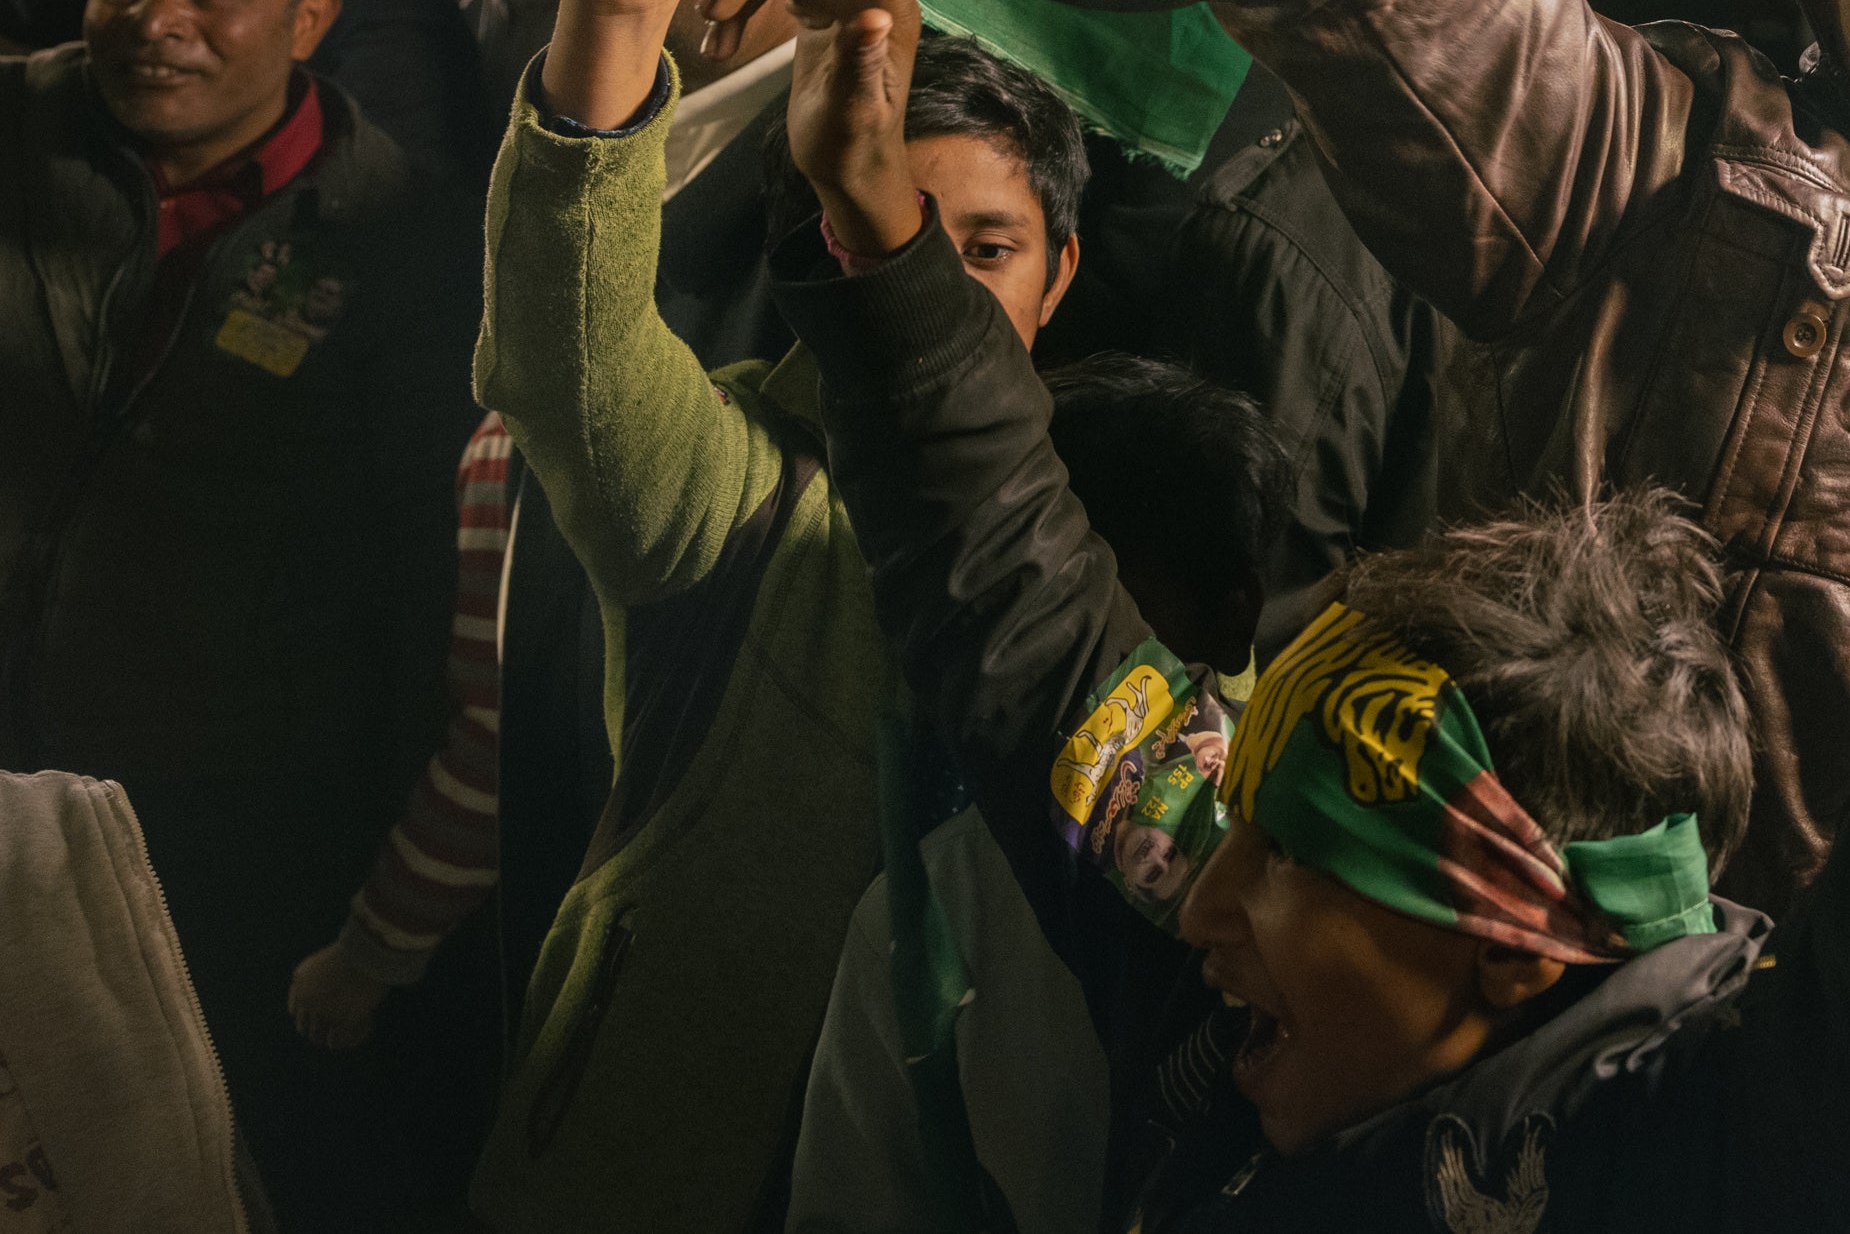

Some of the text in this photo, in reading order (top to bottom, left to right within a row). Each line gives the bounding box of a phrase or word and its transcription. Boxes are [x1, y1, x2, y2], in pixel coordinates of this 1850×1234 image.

[1167, 764, 1187, 783] 155
[1178, 772, 1194, 790] PP
[1140, 796, 1160, 817] 122
[1152, 801, 1169, 821] NA
